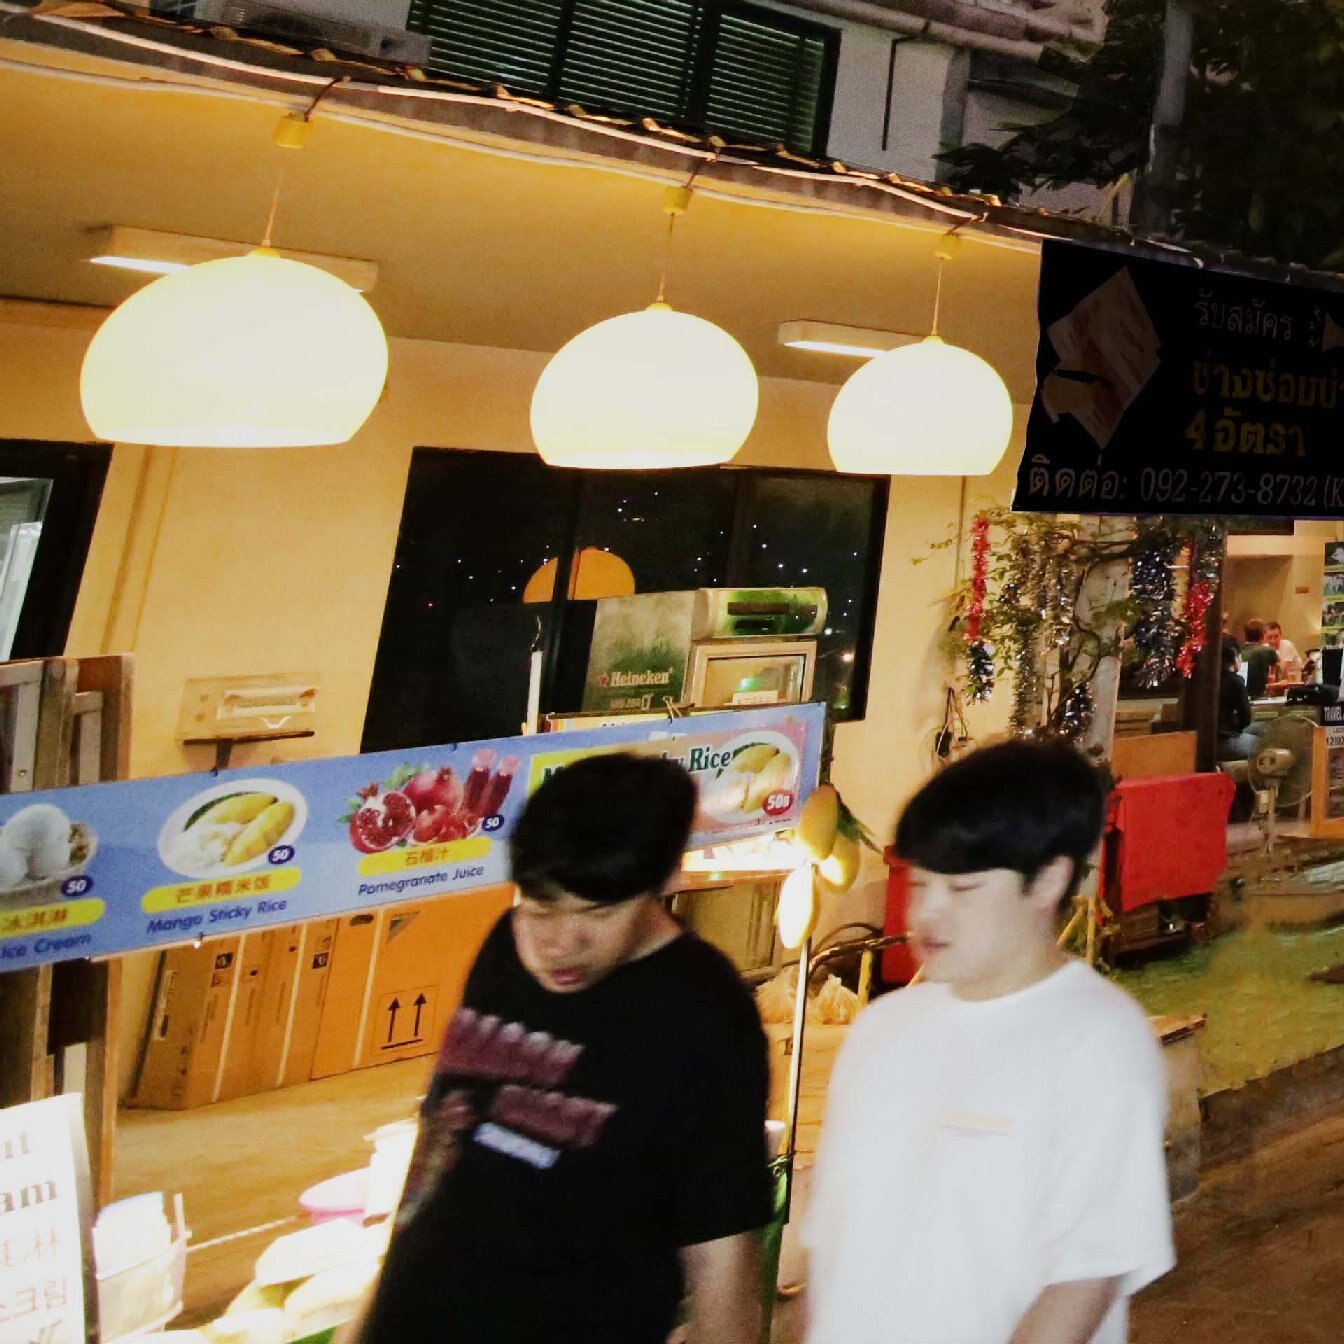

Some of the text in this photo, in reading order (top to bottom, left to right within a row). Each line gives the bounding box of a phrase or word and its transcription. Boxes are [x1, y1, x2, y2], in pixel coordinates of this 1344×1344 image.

[1192, 287, 1296, 342] รับสมัคร
[1184, 406, 1308, 457] 4 อัตรา
[1140, 466, 1317, 506] 092-273-8732
[611, 669, 671, 687] Heineken
[1324, 705, 1342, 722] TRAVEL
[688, 746, 731, 773] Rice
[484, 816, 500, 830] 50
[272, 849, 288, 862] 50
[66, 878, 87, 895] 50
[357, 864, 485, 896] Pomegranate Juice
[146, 899, 288, 935] Mango Sticky Rice
[34, 933, 92, 954] Cream
